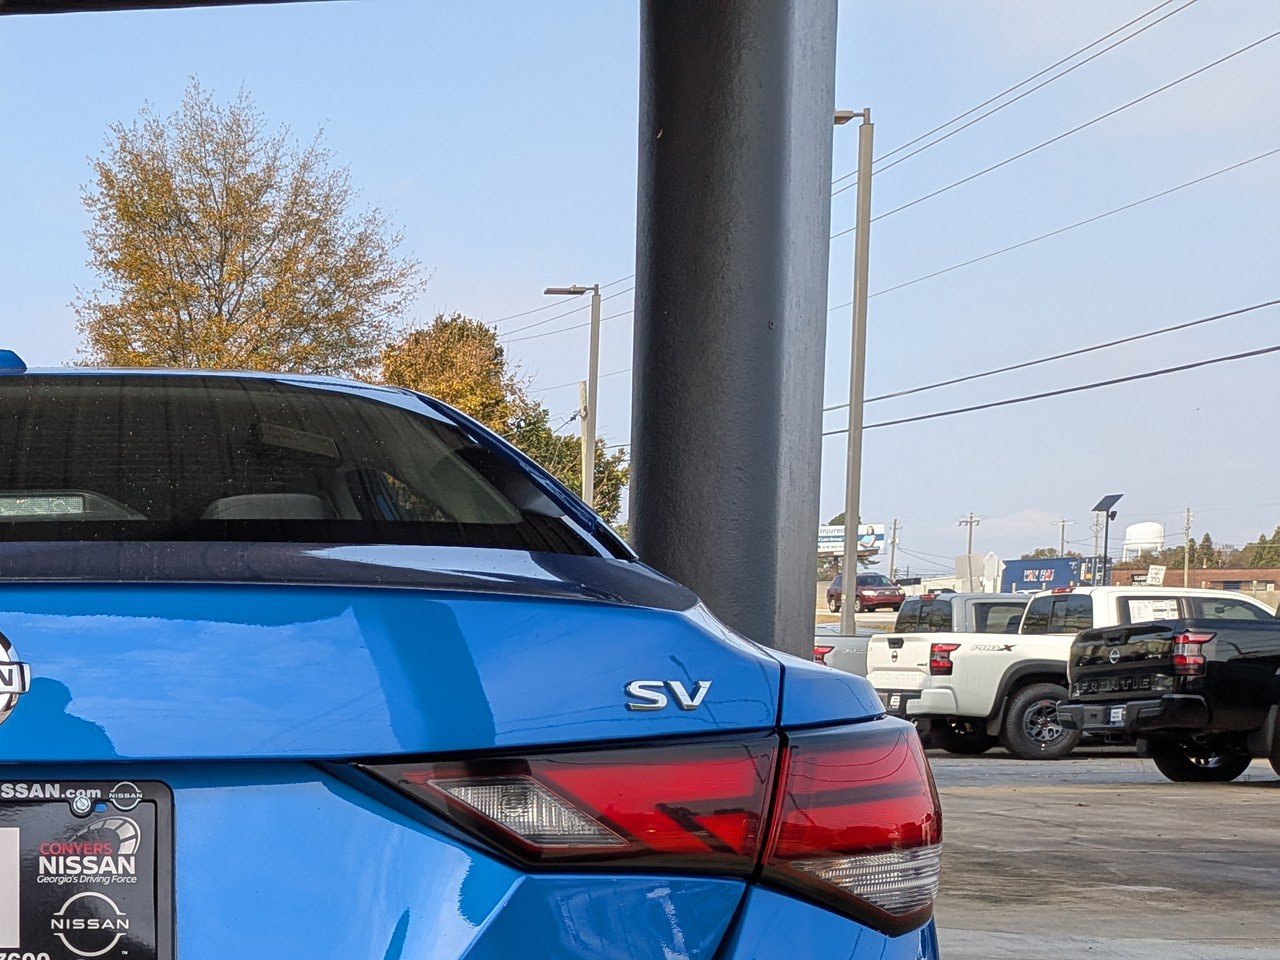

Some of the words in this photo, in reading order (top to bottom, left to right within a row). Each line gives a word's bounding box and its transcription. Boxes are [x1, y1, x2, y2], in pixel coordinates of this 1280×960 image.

[624, 680, 712, 711] SV
[39, 842, 112, 855] CONYERS
[38, 856, 136, 875] NISSAN
[36, 875, 78, 885] Georgia's
[79, 875, 111, 885] Driving
[111, 875, 138, 883] Force
[50, 918, 130, 930] NISSAN
